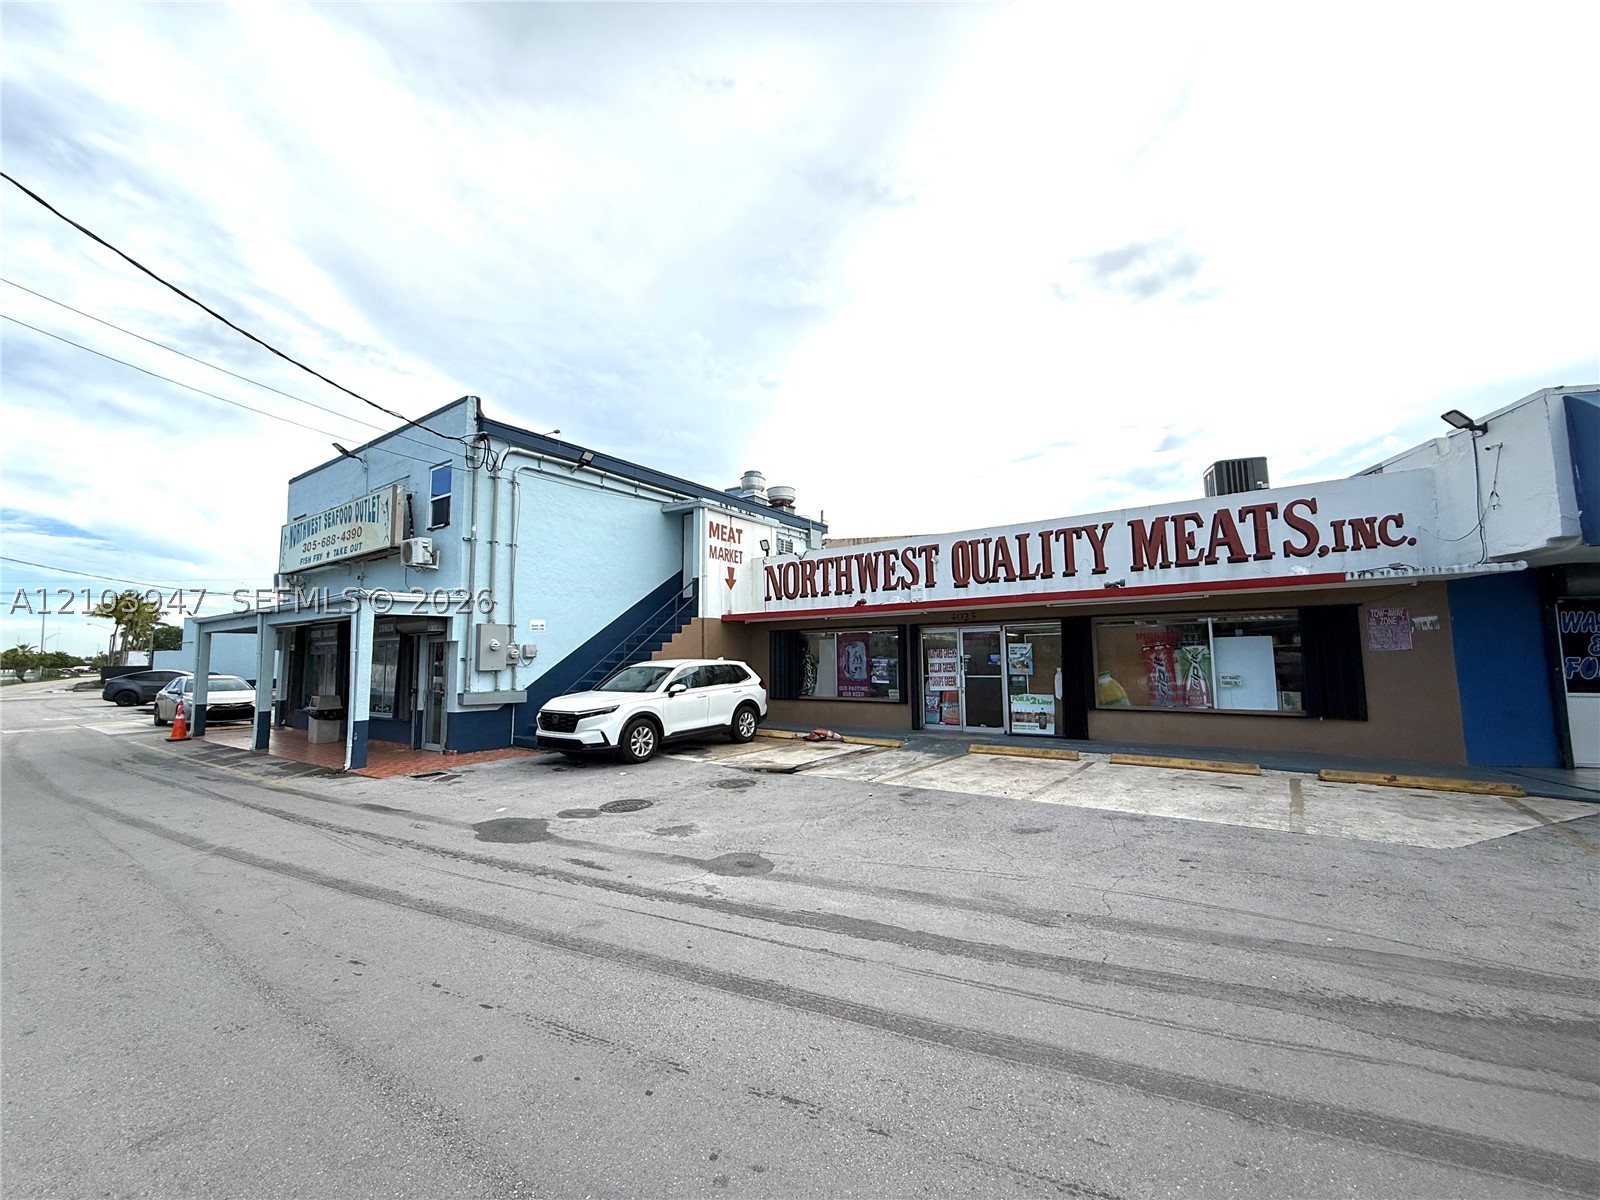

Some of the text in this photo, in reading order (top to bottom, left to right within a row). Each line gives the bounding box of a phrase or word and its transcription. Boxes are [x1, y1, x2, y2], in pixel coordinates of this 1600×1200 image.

[288, 493, 381, 551] NORTHWEST SEAFOOD OUTLET
[708, 520, 743, 545] MEAT
[302, 526, 363, 553] 305-688-4390
[333, 542, 363, 557] TAKE OUT
[300, 552, 323, 566] FISH FRY
[708, 545, 744, 565] MARKET
[764, 543, 940, 601] NORTHWEST
[951, 521, 1114, 589] QUALITY
[1370, 609, 1404, 618] TOW-AWAY
[1380, 617, 1398, 626] ZONE
[1561, 610, 1600, 633] WA
[1565, 656, 1600, 680] FO
